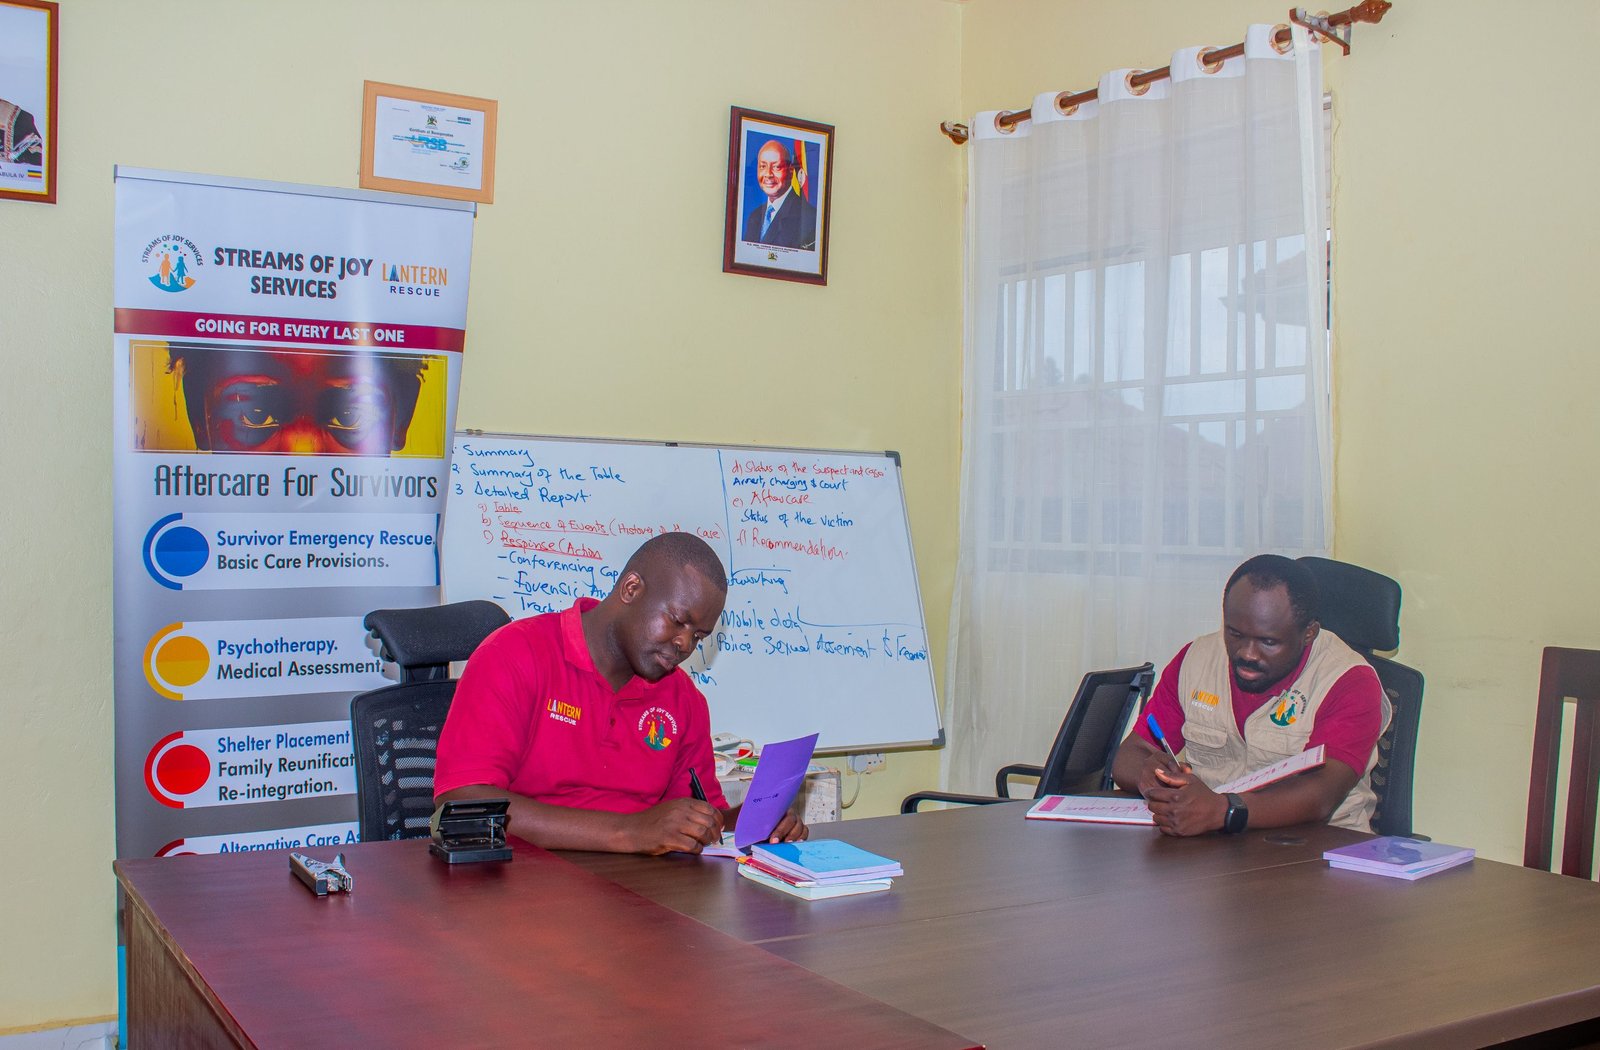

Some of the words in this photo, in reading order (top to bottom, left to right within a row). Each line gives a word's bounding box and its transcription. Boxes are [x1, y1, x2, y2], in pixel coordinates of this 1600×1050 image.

[142, 237, 161, 264] STREAMS
[172, 235, 184, 243] JOY
[184, 239, 203, 266] SERVICES
[214, 247, 304, 272] STREAMS
[310, 254, 334, 274] OF
[338, 257, 374, 281] JOY
[382, 263, 448, 287] LANTERN
[250, 275, 337, 299] SERVICES
[390, 285, 440, 297] RESCUE
[195, 318, 245, 336] GOING
[250, 321, 280, 337] FOR
[284, 323, 330, 339] EVERY
[333, 326, 370, 341] LAST
[374, 328, 405, 343] ONE
[463, 445, 534, 467] Summary
[154, 464, 270, 498] Aftercare
[283, 466, 318, 498] For
[330, 467, 438, 498] Survivors
[470, 464, 533, 487] Summary
[537, 469, 552, 483] of
[560, 468, 586, 481] the
[590, 466, 625, 483] Table
[474, 481, 529, 500] Detailed
[741, 509, 768, 524] Status
[794, 511, 816, 525] the
[216, 530, 284, 547] Survivor
[289, 529, 374, 549] Emergency
[380, 530, 436, 546] Rescue.
[217, 553, 259, 570] Basic
[264, 553, 302, 569] Care
[307, 552, 389, 569] Provisions.
[721, 604, 765, 630] Mobile
[217, 636, 338, 656] Psychotherapy.
[217, 660, 282, 680] Medical
[288, 659, 386, 677] Assessment.
[547, 698, 581, 720] LANTERN
[550, 712, 577, 726] RESCUE
[218, 735, 271, 754] Shelter
[276, 730, 350, 750] Placement
[218, 758, 272, 778] Family
[218, 779, 338, 801] Re-integration.
[306, 833, 340, 847] Care
